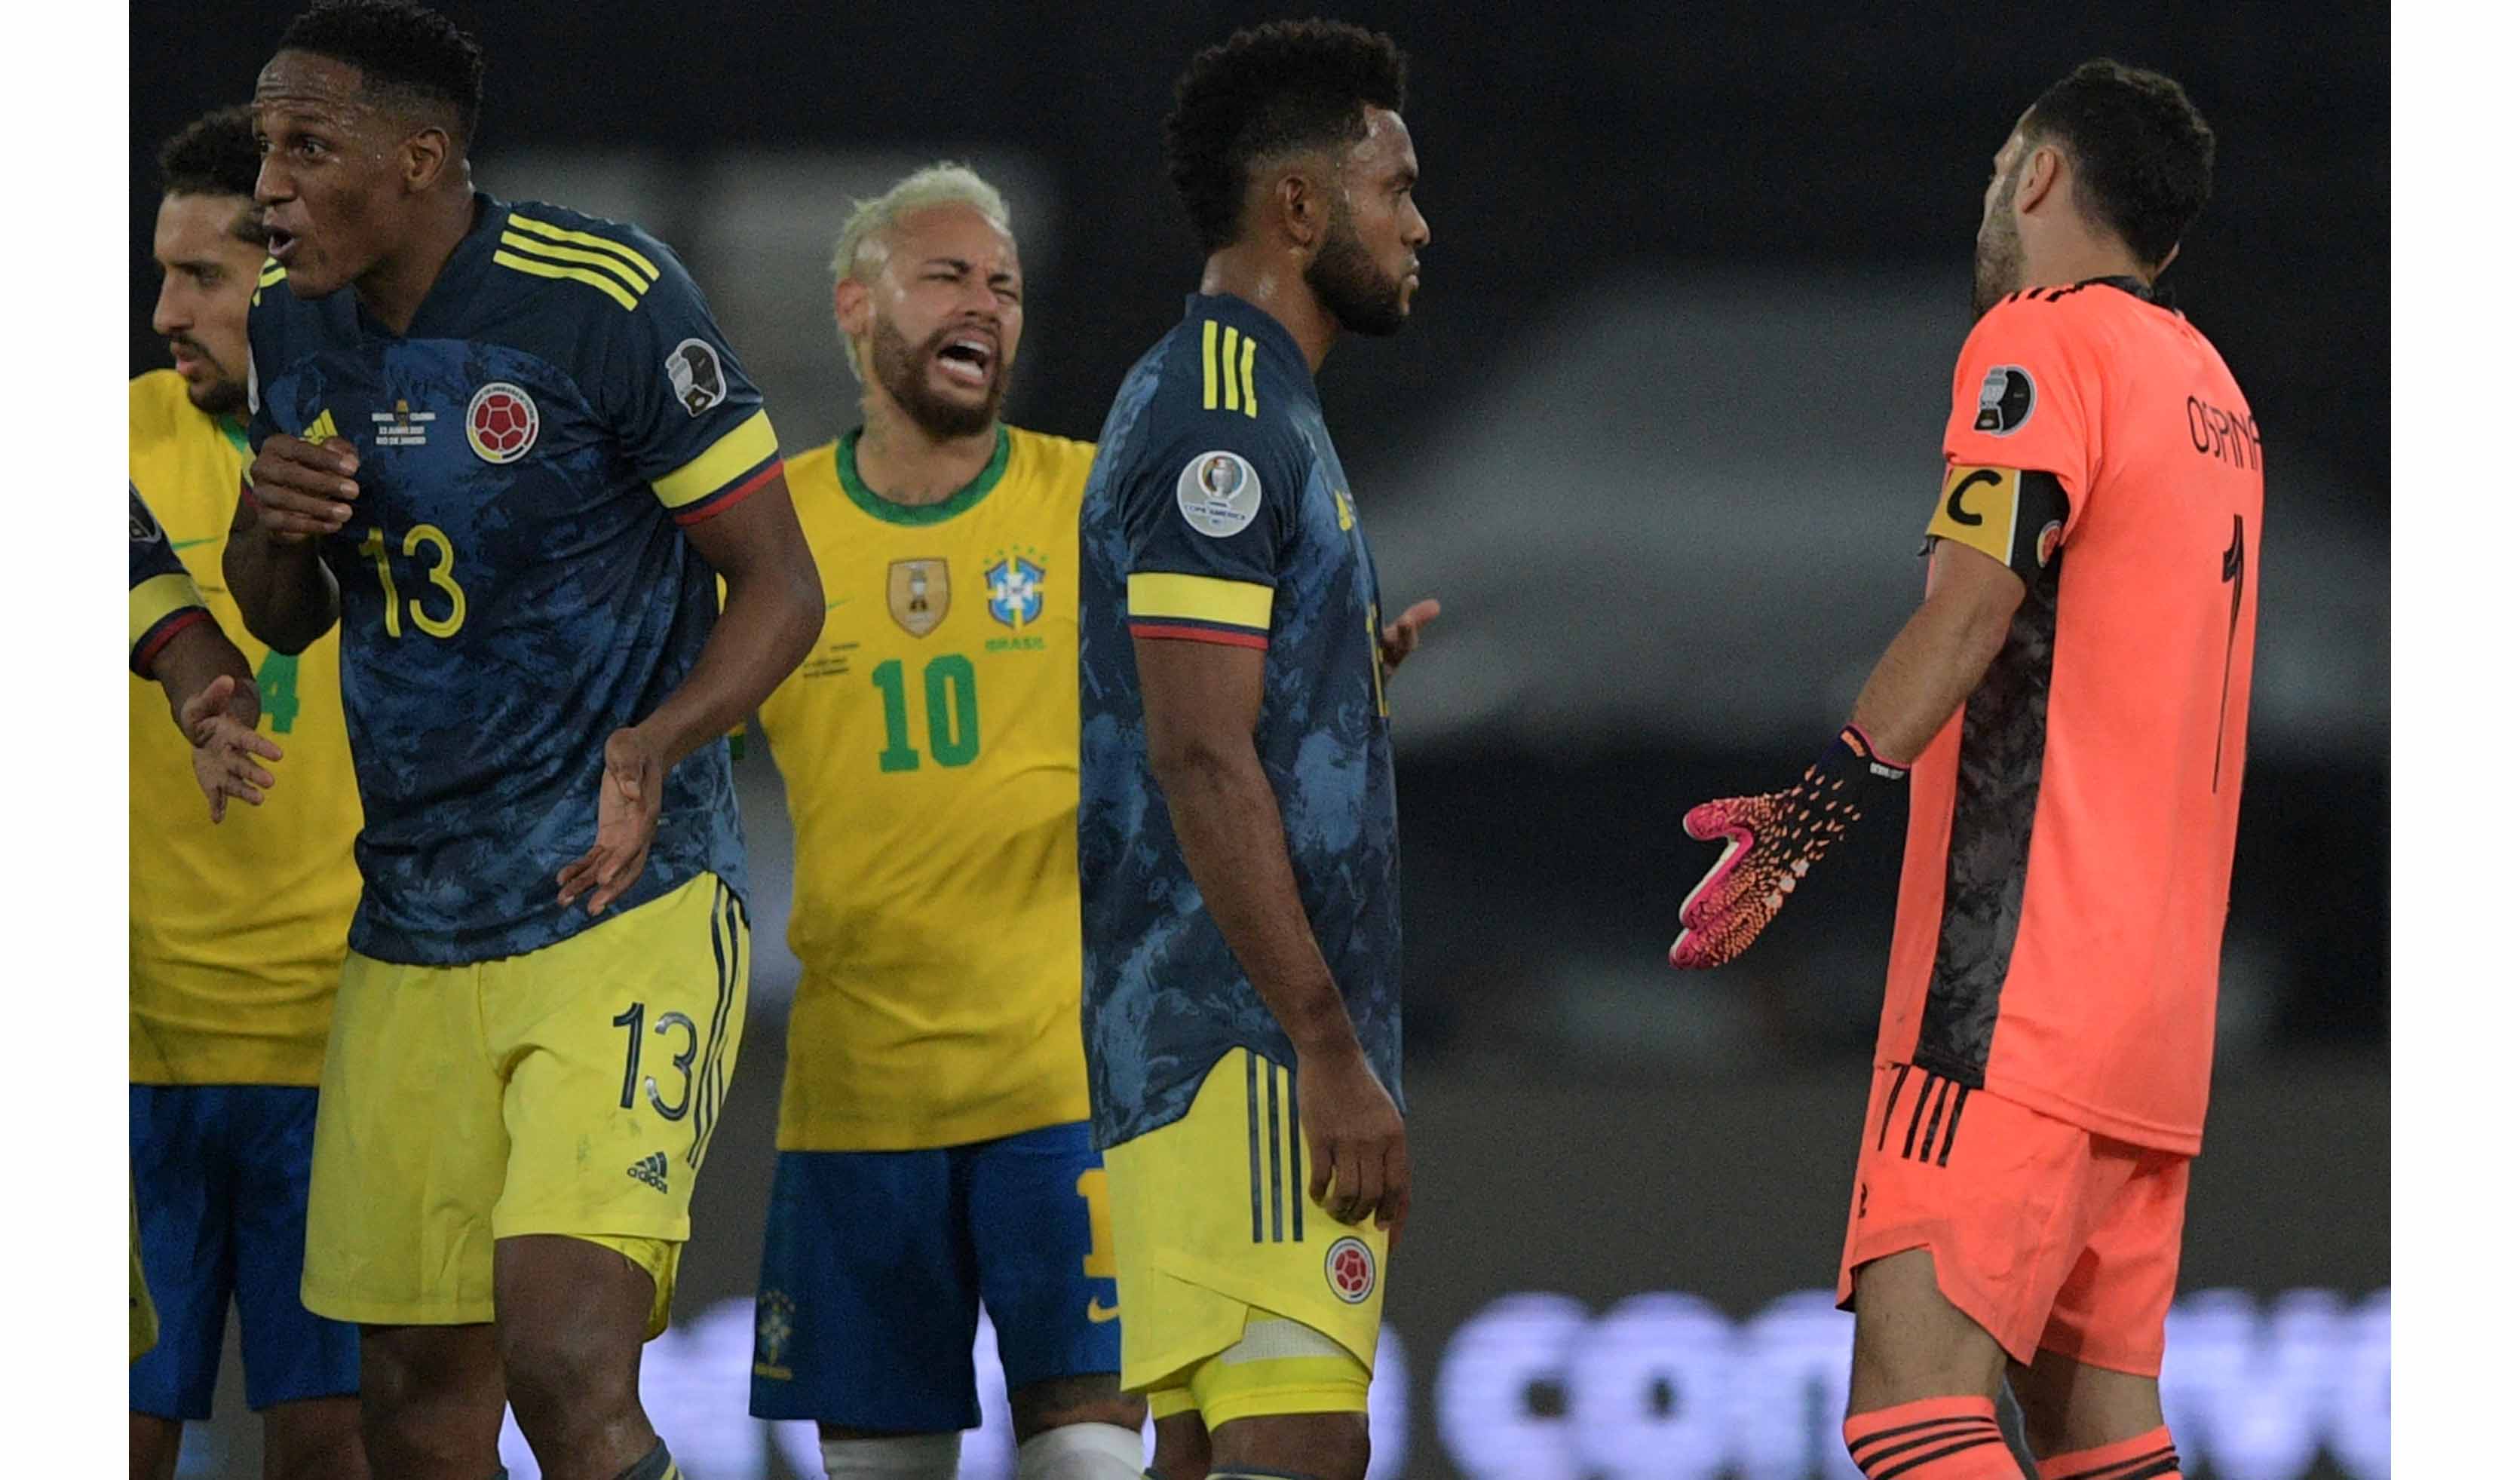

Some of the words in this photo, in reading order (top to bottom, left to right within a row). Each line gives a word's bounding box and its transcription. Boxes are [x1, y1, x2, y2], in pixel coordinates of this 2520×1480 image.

[1947, 470, 2002, 526] C
[360, 524, 466, 639] 13
[257, 649, 299, 733] 4
[2212, 514, 2244, 794] 1
[872, 653, 979, 773] 10
[613, 1002, 697, 1122] 13
[627, 1168, 667, 1194] adidas
